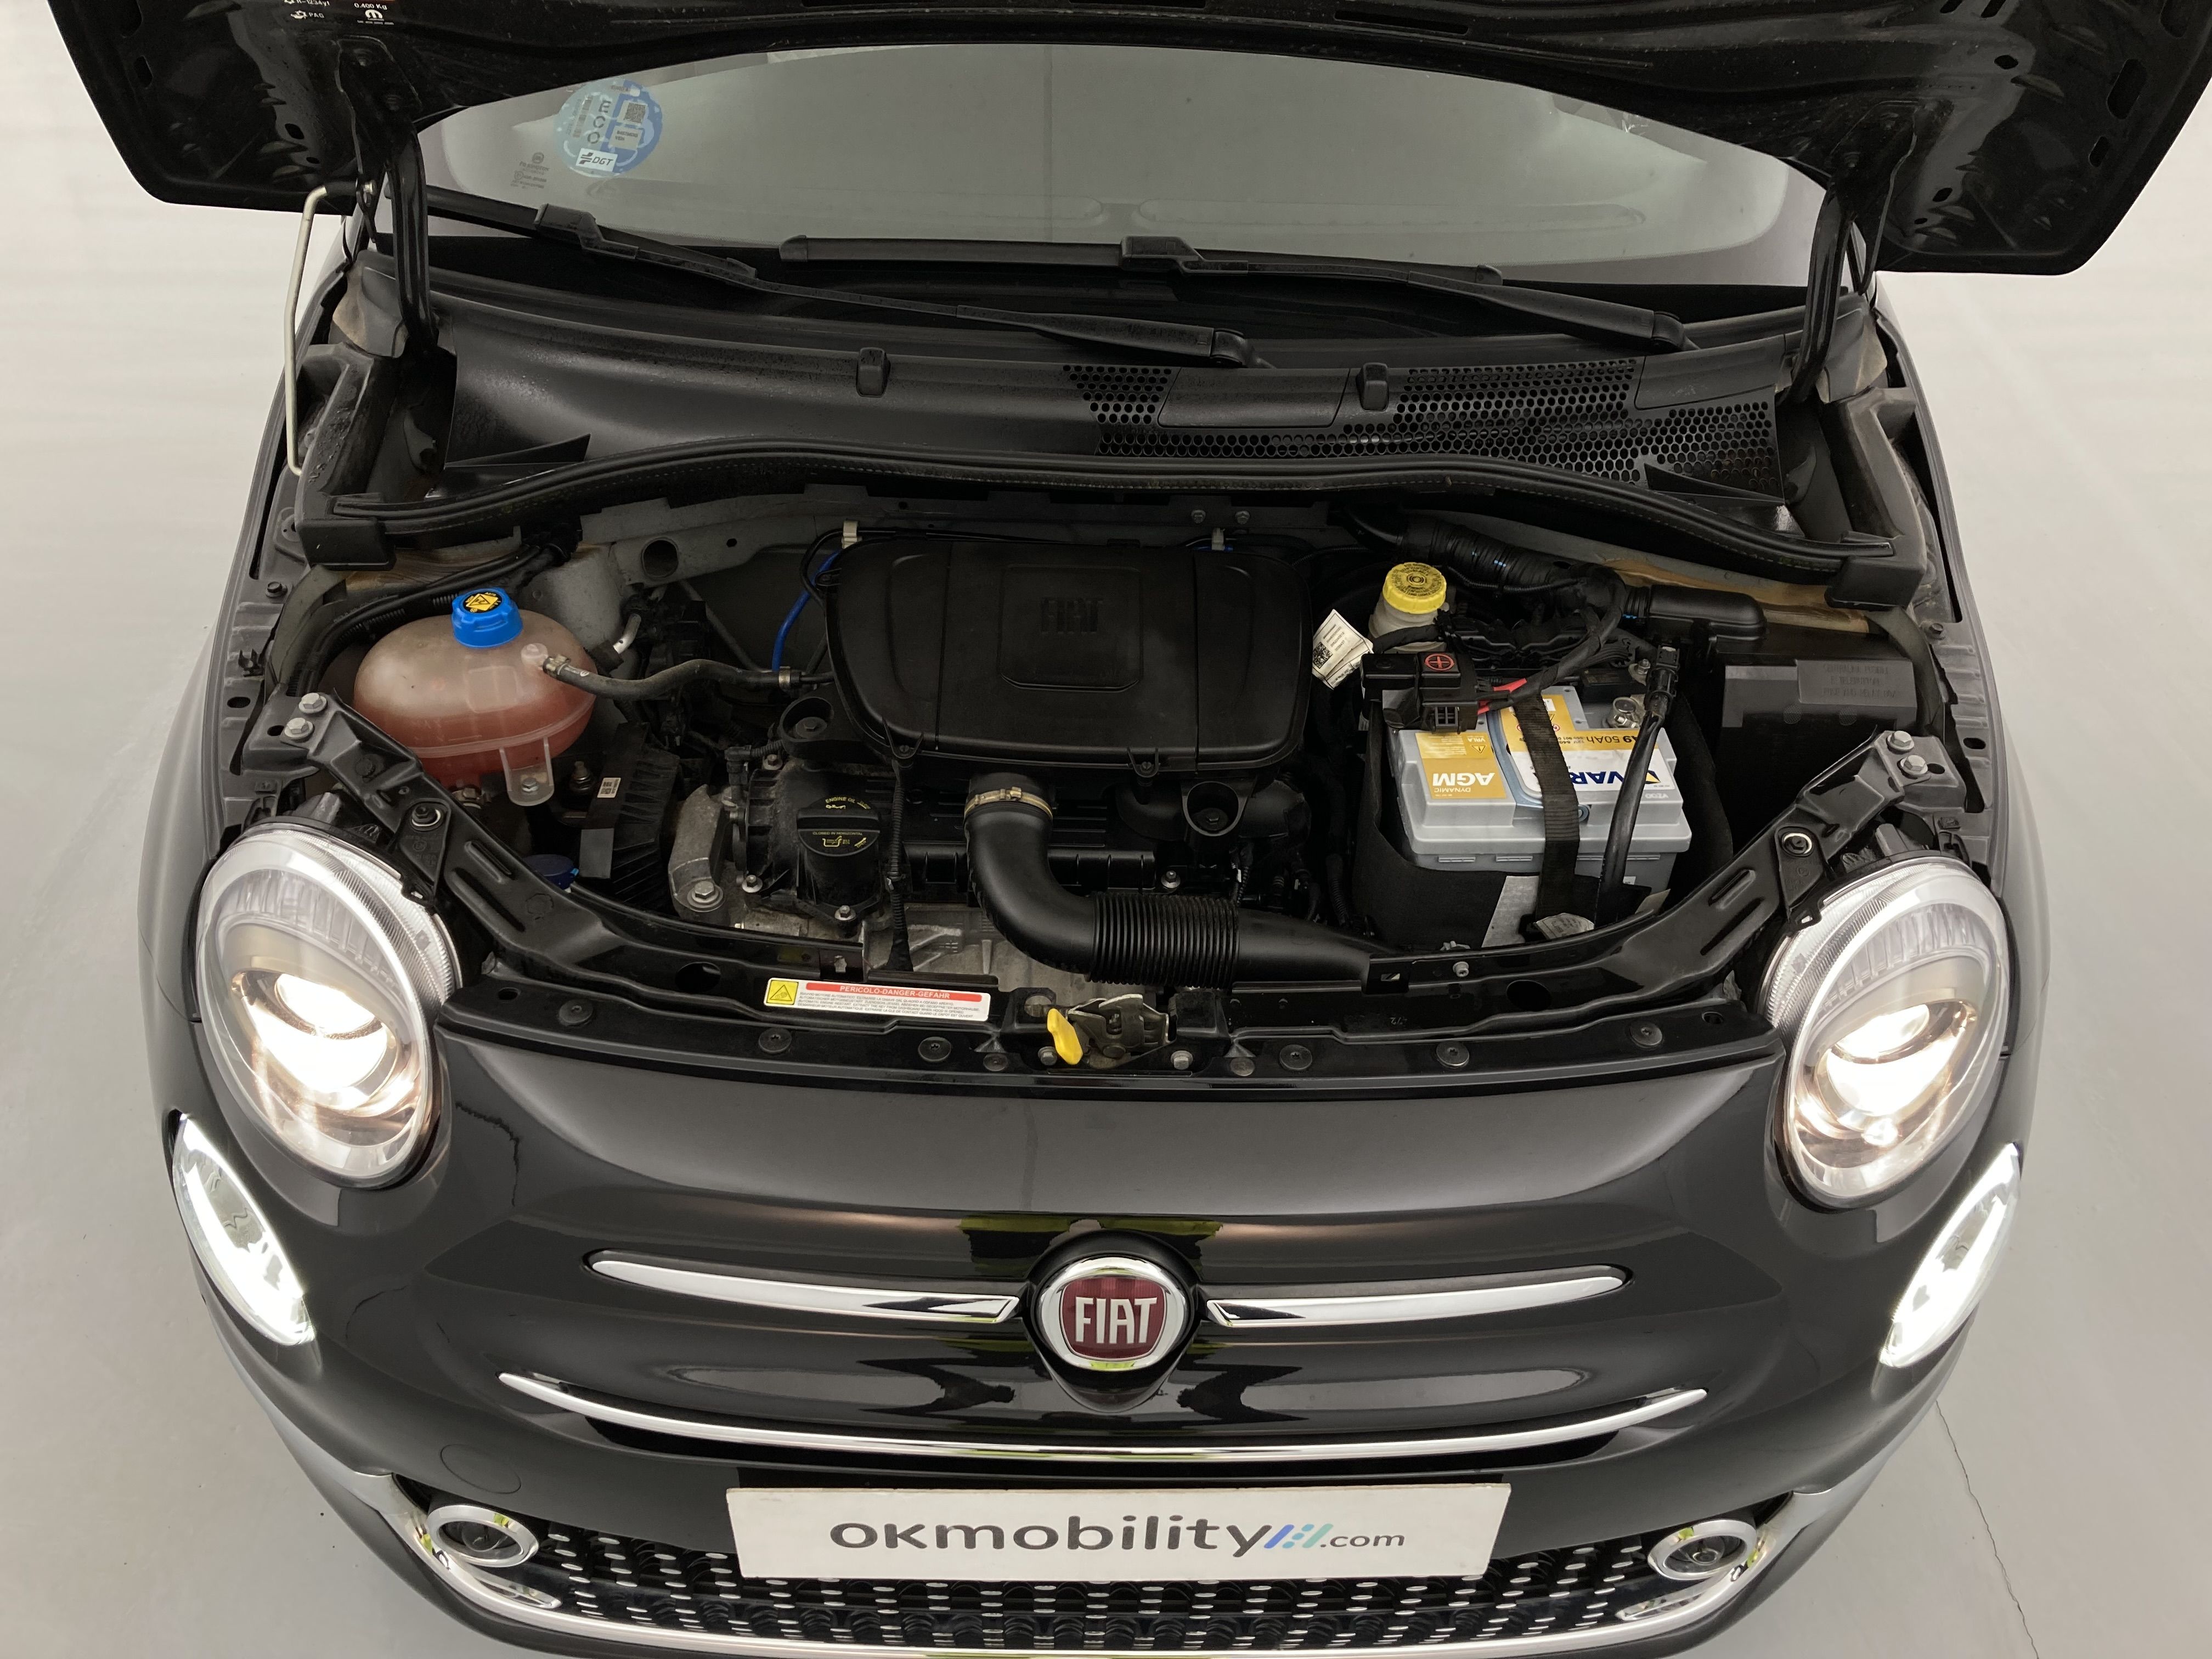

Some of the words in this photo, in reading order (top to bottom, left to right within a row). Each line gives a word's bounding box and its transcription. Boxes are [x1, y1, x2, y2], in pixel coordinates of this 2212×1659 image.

[592, 156, 614, 166] DGT
[1586, 735, 1620, 744] 50Ah
[1432, 772, 1496, 787] AGM
[839, 985, 951, 999] PERICOLO-DANGER-GEFAHR
[1075, 1296, 1158, 1344] FIAT
[830, 1515, 1273, 1558] okmobility
[1320, 1534, 1406, 1548] .com
